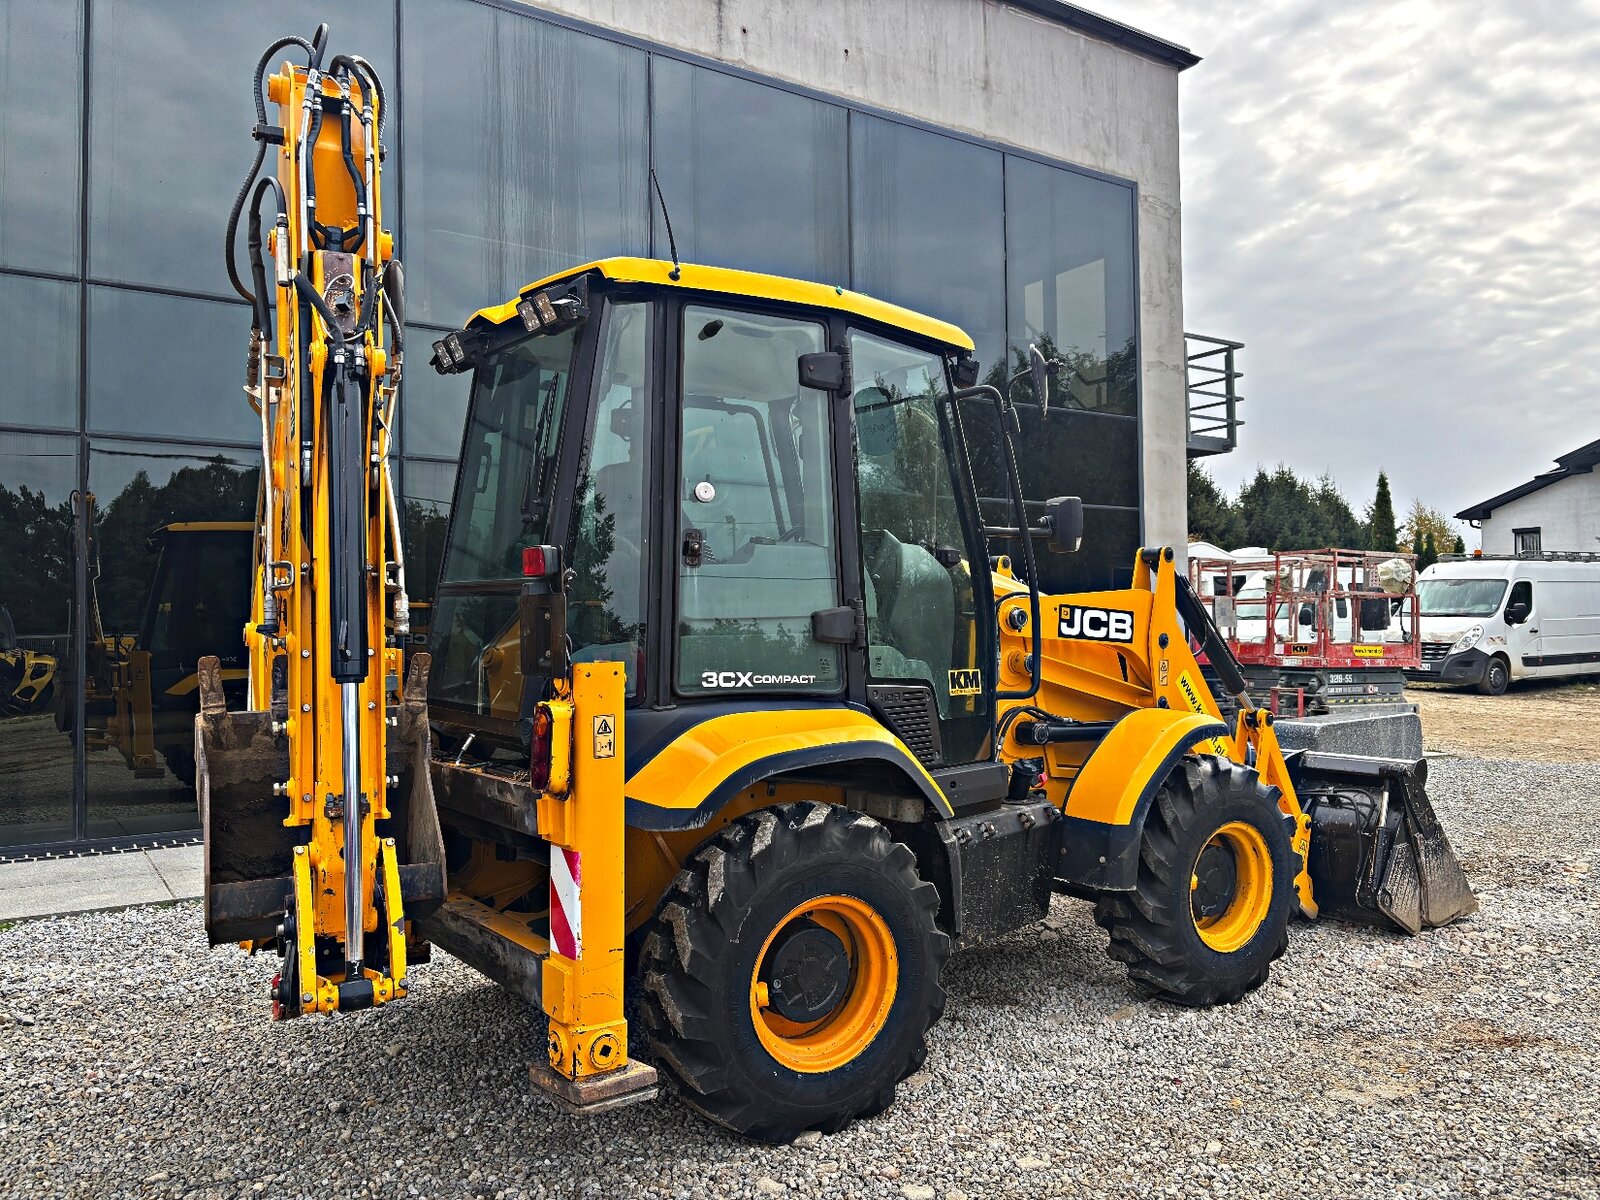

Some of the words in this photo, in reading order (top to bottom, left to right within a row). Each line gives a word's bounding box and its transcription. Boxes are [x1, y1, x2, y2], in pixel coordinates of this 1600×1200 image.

[1060, 608, 1132, 640] JCB
[1293, 645, 1308, 653] KM
[701, 671, 754, 688] 3CX
[753, 675, 816, 684] COMPACT
[950, 671, 980, 689] KM
